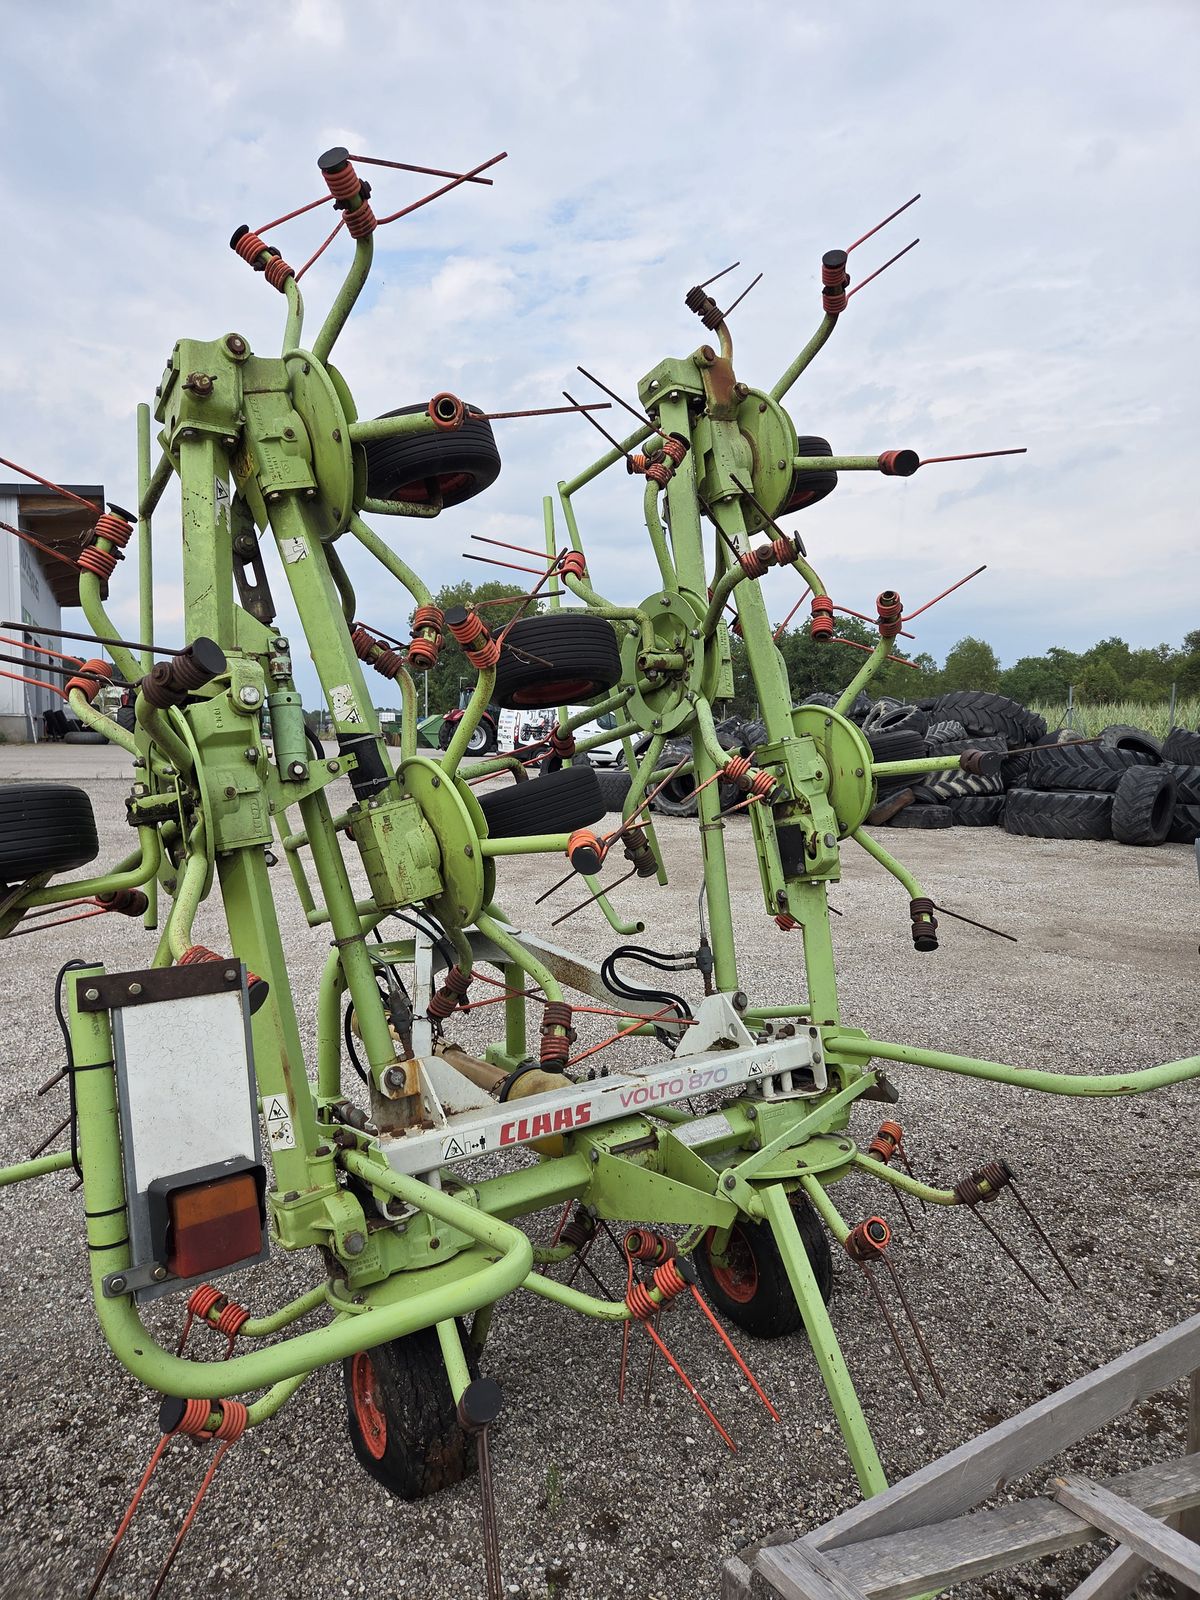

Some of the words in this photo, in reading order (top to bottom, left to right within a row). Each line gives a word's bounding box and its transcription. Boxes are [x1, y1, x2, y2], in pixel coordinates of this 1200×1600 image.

[619, 1078, 684, 1108] VOLTO
[688, 1067, 728, 1090] 870
[500, 1101, 592, 1146] CLAAS
